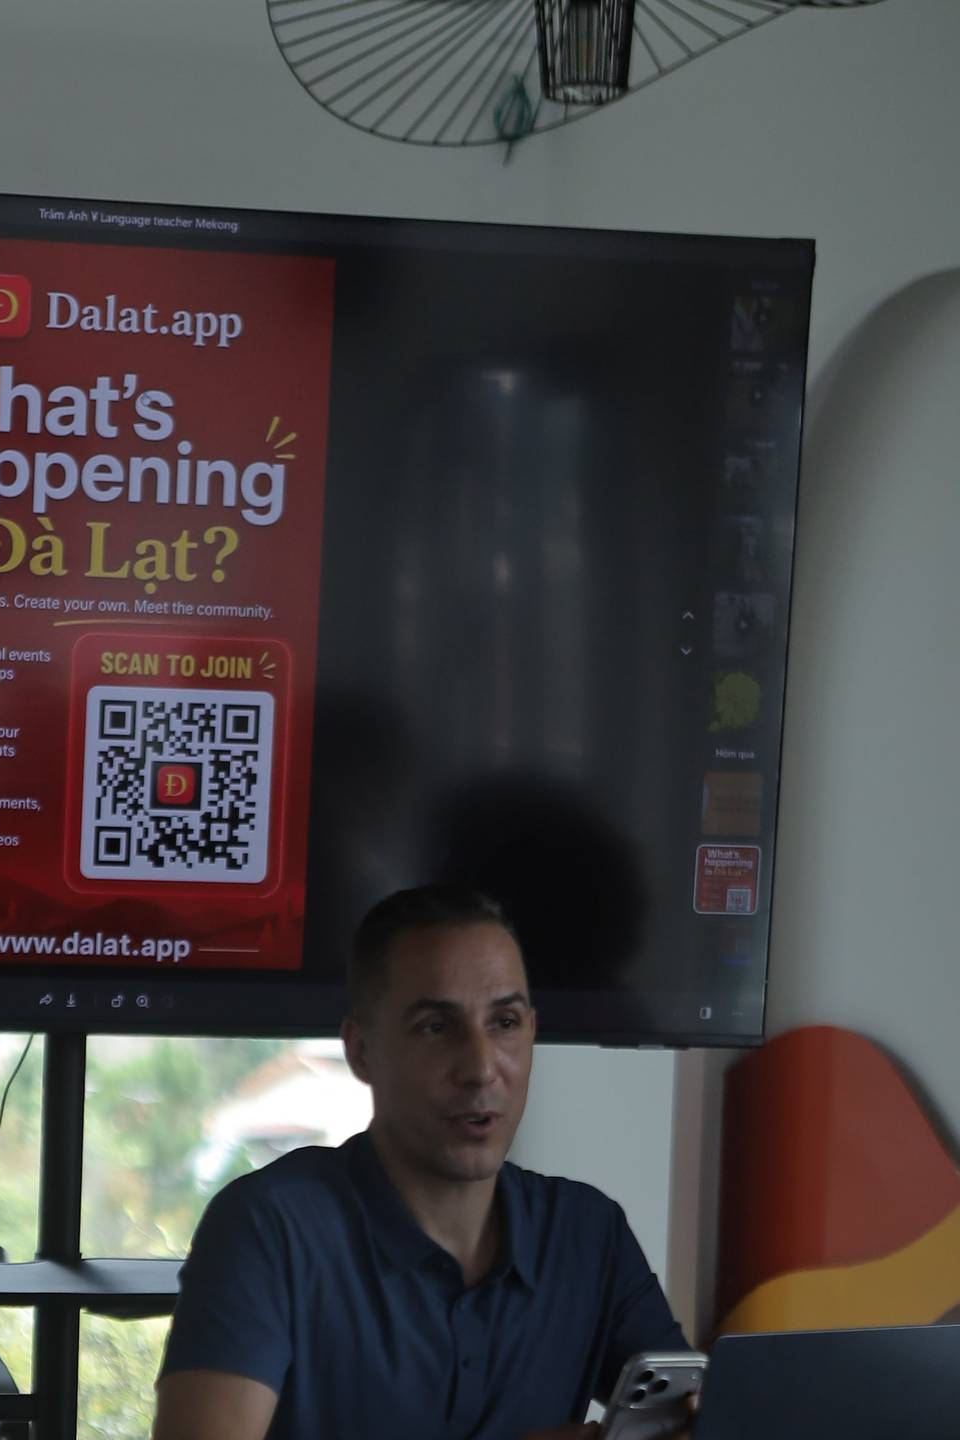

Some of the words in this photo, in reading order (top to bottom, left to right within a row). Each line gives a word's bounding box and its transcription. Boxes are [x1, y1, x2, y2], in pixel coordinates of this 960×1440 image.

[67, 210, 88, 222] Anh
[100, 212, 151, 228] Language
[153, 216, 193, 228] teacher
[195, 218, 239, 233] Mekong
[46, 291, 243, 348] Dalat.app
[84, 521, 240, 594] Lạt?
[13, 594, 60, 611] Create
[63, 598, 95, 614] your
[97, 599, 131, 613] own.
[134, 600, 170, 614] Meet
[172, 601, 194, 616] the
[196, 603, 275, 621] community.
[8, 648, 52, 663] events
[100, 650, 160, 676] SCAN
[166, 653, 196, 677] TO
[199, 655, 253, 679] JOIN
